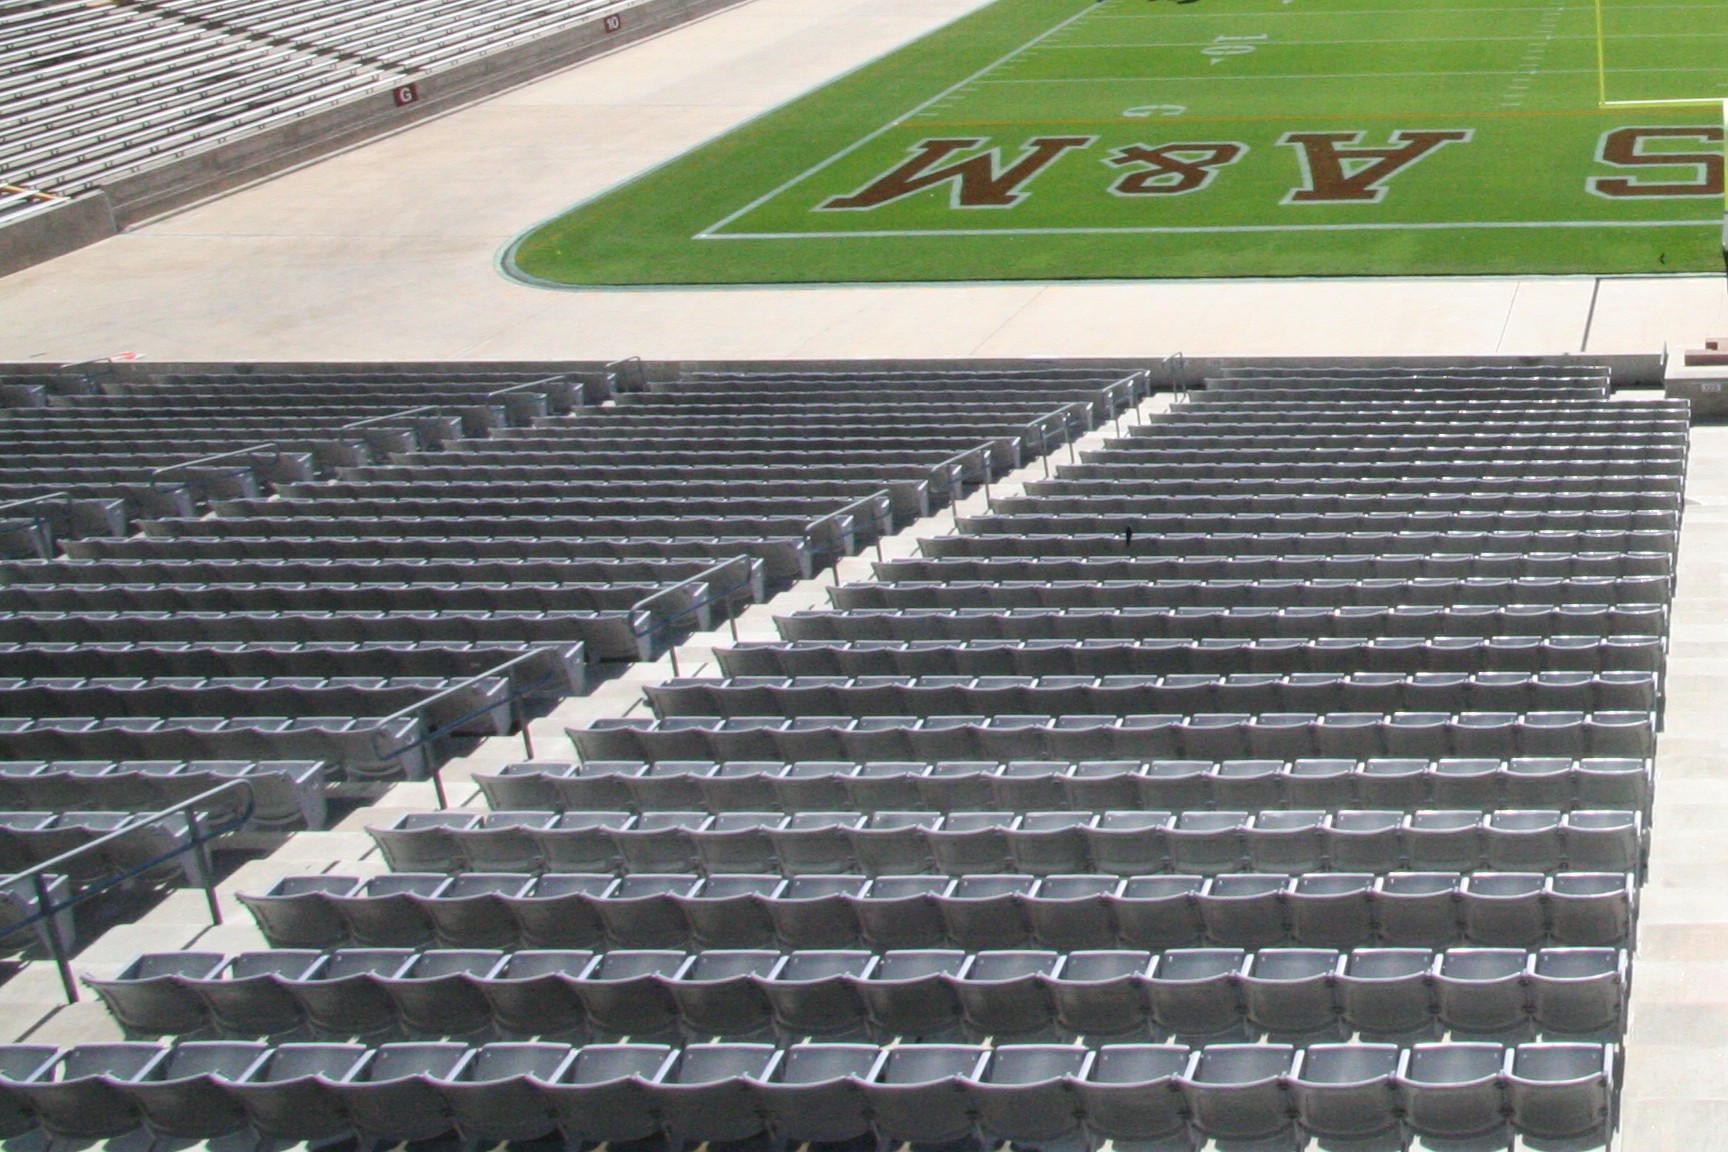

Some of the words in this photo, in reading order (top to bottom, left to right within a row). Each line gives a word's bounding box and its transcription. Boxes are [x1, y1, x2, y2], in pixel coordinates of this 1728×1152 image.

[606, 16, 619, 30] 10
[1201, 33, 1268, 55] 10
[399, 87, 413, 103] G
